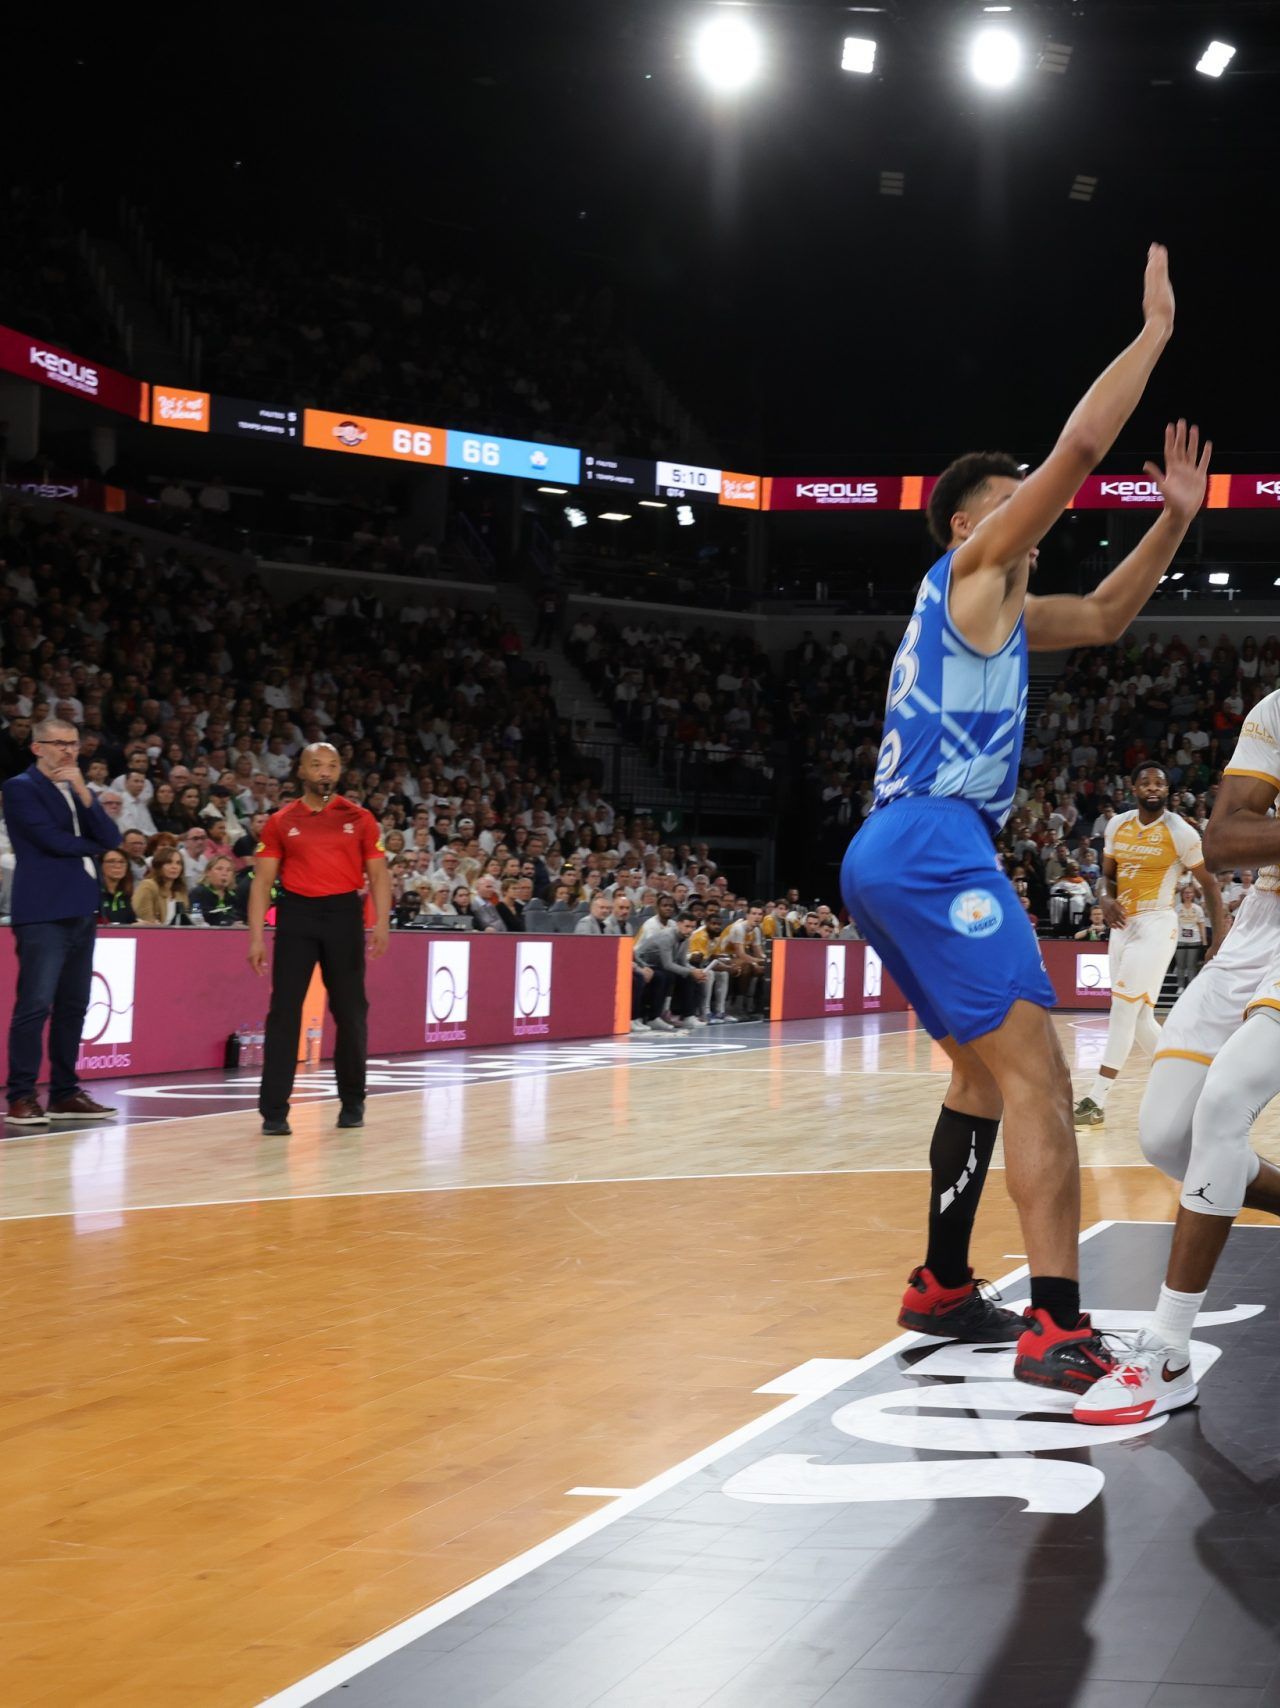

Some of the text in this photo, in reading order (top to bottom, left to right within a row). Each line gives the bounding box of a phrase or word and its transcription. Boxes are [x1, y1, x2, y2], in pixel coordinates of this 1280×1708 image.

[393, 429, 432, 457] 66
[462, 439, 500, 466] 66
[672, 469, 708, 486] 5:10
